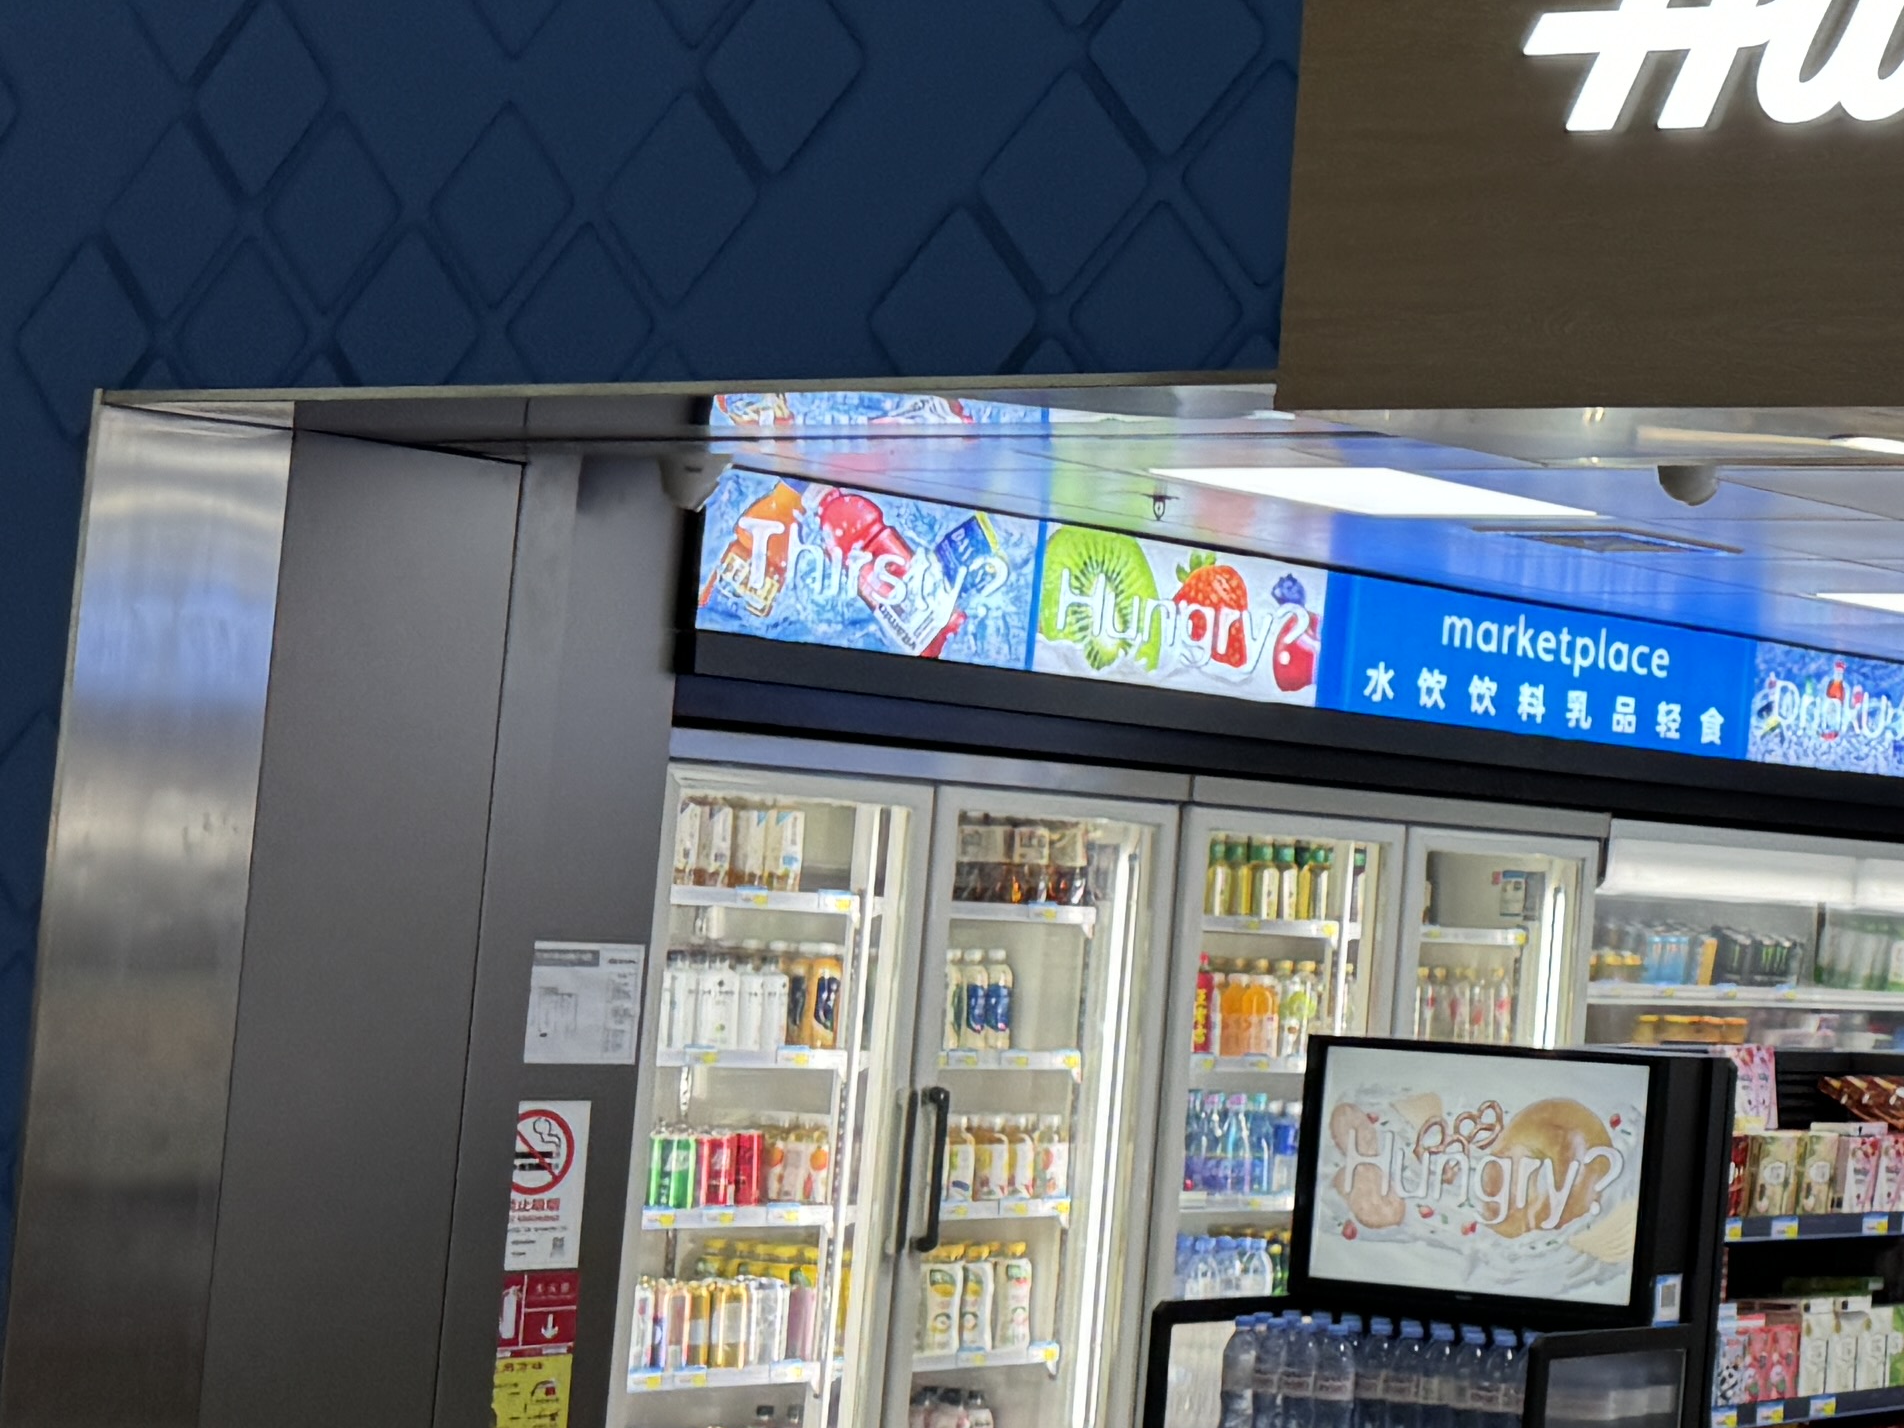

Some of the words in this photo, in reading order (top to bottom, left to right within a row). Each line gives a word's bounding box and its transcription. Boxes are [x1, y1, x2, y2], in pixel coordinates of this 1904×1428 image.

[736, 512, 1009, 643] Thirsty?
[1055, 569, 1311, 680] Hungry?
[1442, 610, 1671, 680] marketplace
[1364, 661, 1725, 745] 水饮饮料乳品轻食
[1344, 1127, 1625, 1230] Hungry?
